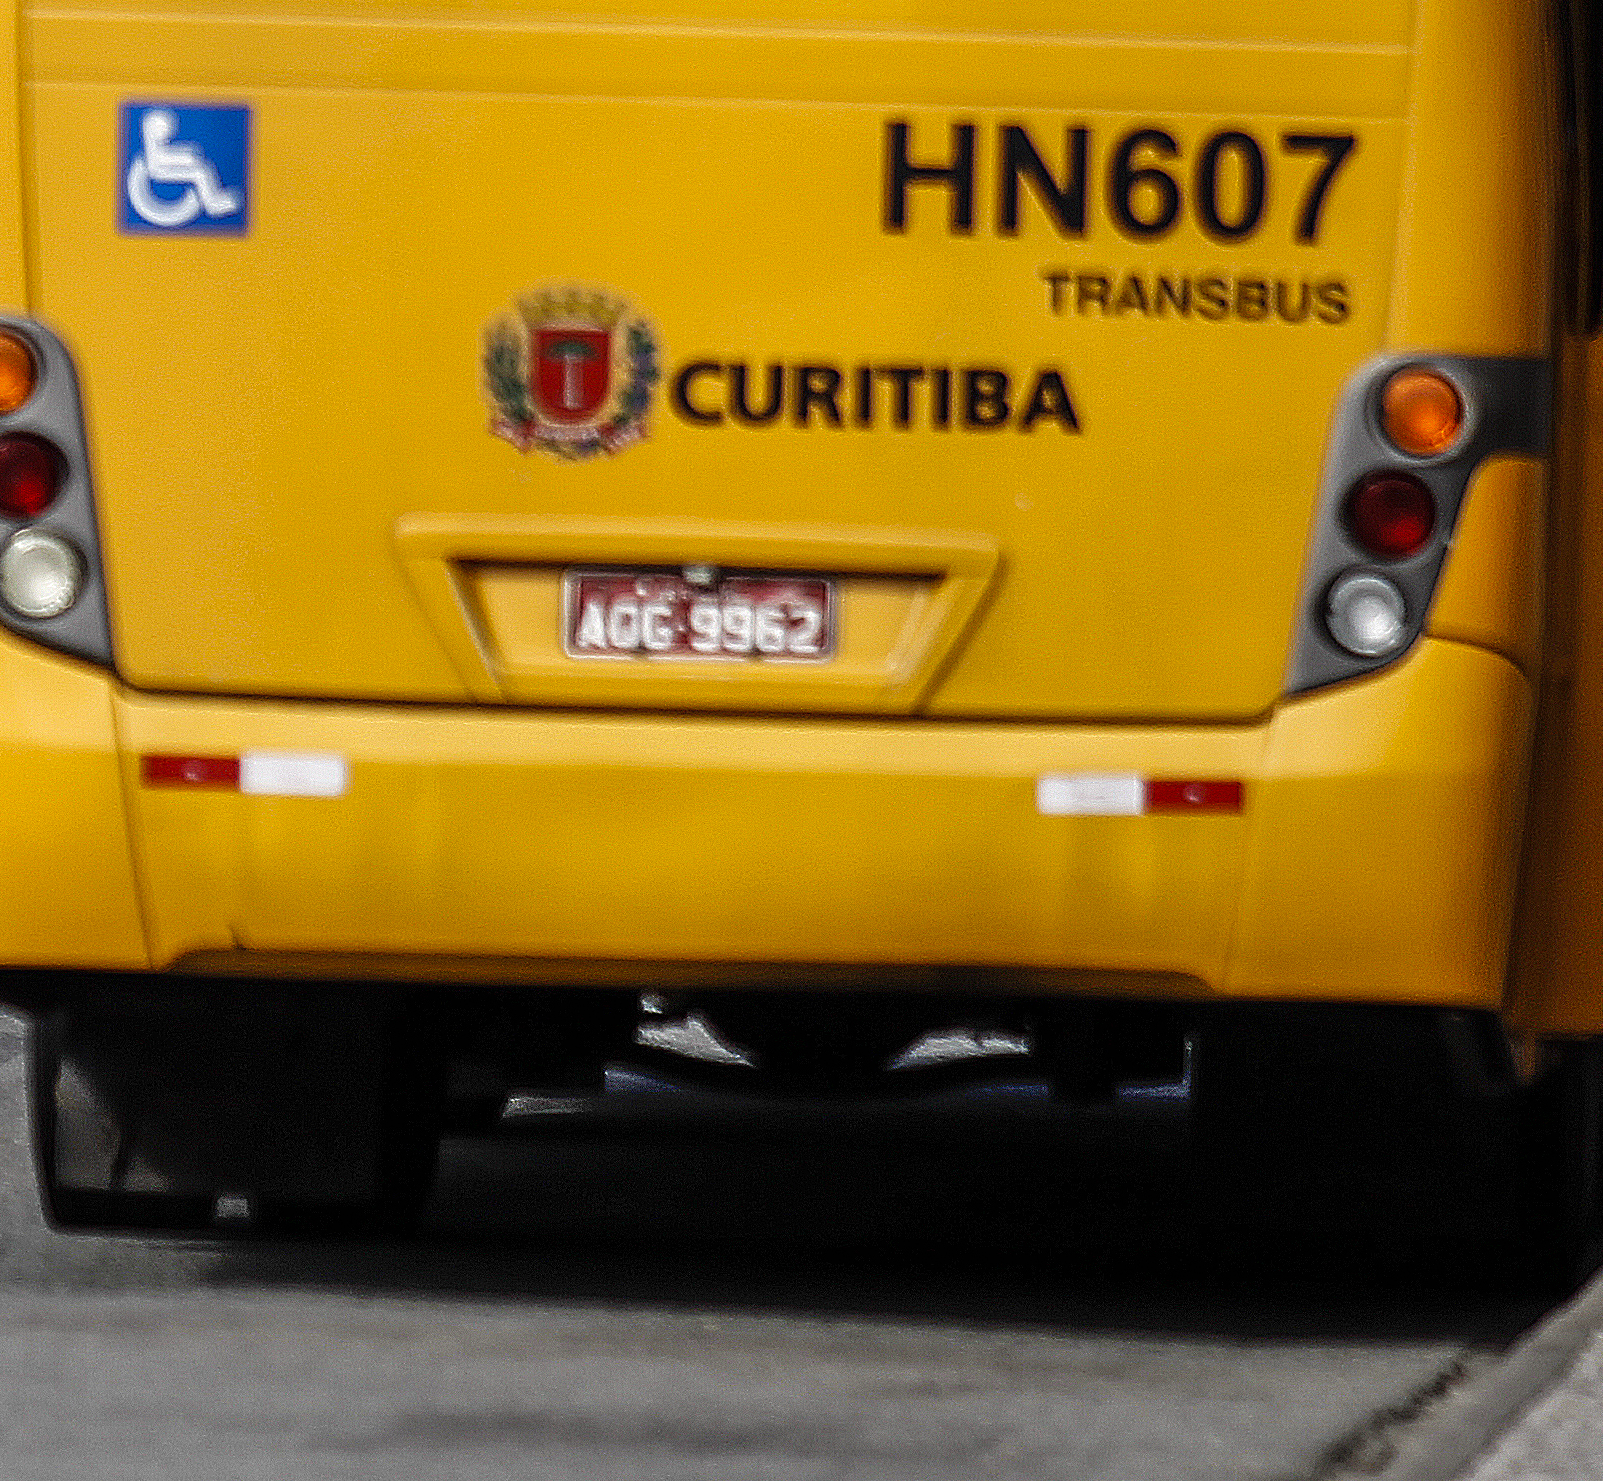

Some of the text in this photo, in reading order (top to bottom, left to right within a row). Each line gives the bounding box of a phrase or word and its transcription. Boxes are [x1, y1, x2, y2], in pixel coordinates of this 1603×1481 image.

[883, 119, 1357, 247] HN607
[1044, 270, 1351, 324] TRANSBUS
[670, 361, 1083, 434] CURITIBA
[691, 603, 822, 652] 9962
